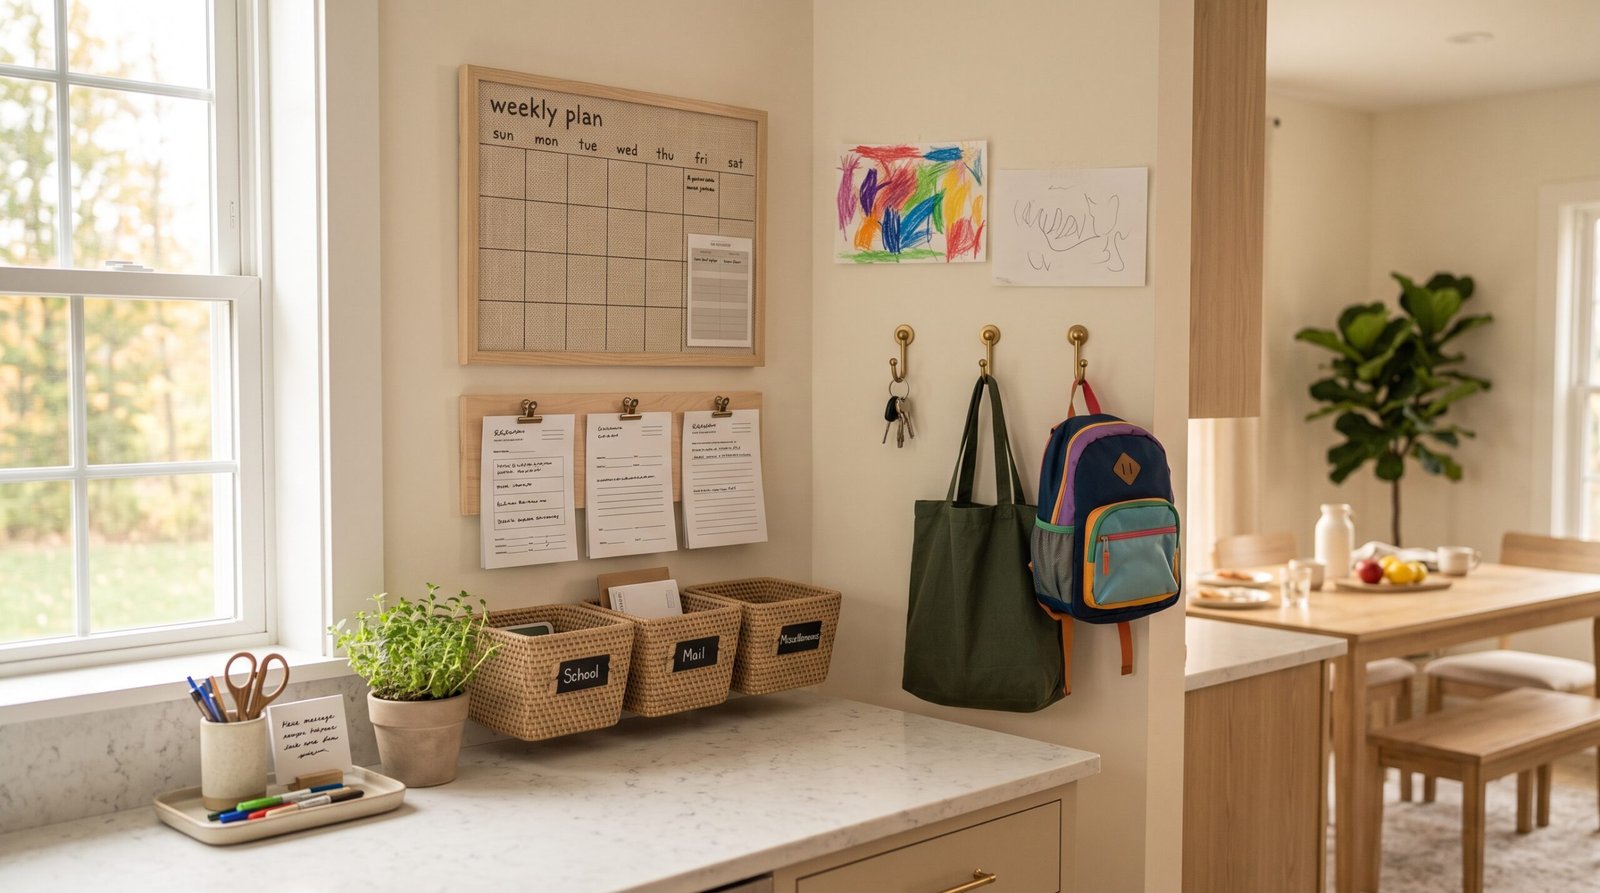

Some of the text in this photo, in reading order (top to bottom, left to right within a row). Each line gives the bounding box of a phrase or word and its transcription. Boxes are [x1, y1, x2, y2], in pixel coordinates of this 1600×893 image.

[490, 97, 602, 130] weekly plan
[493, 129, 744, 169] sun mon tue wed thu fri sat
[682, 646, 705, 663] Mail
[563, 664, 599, 684] School
